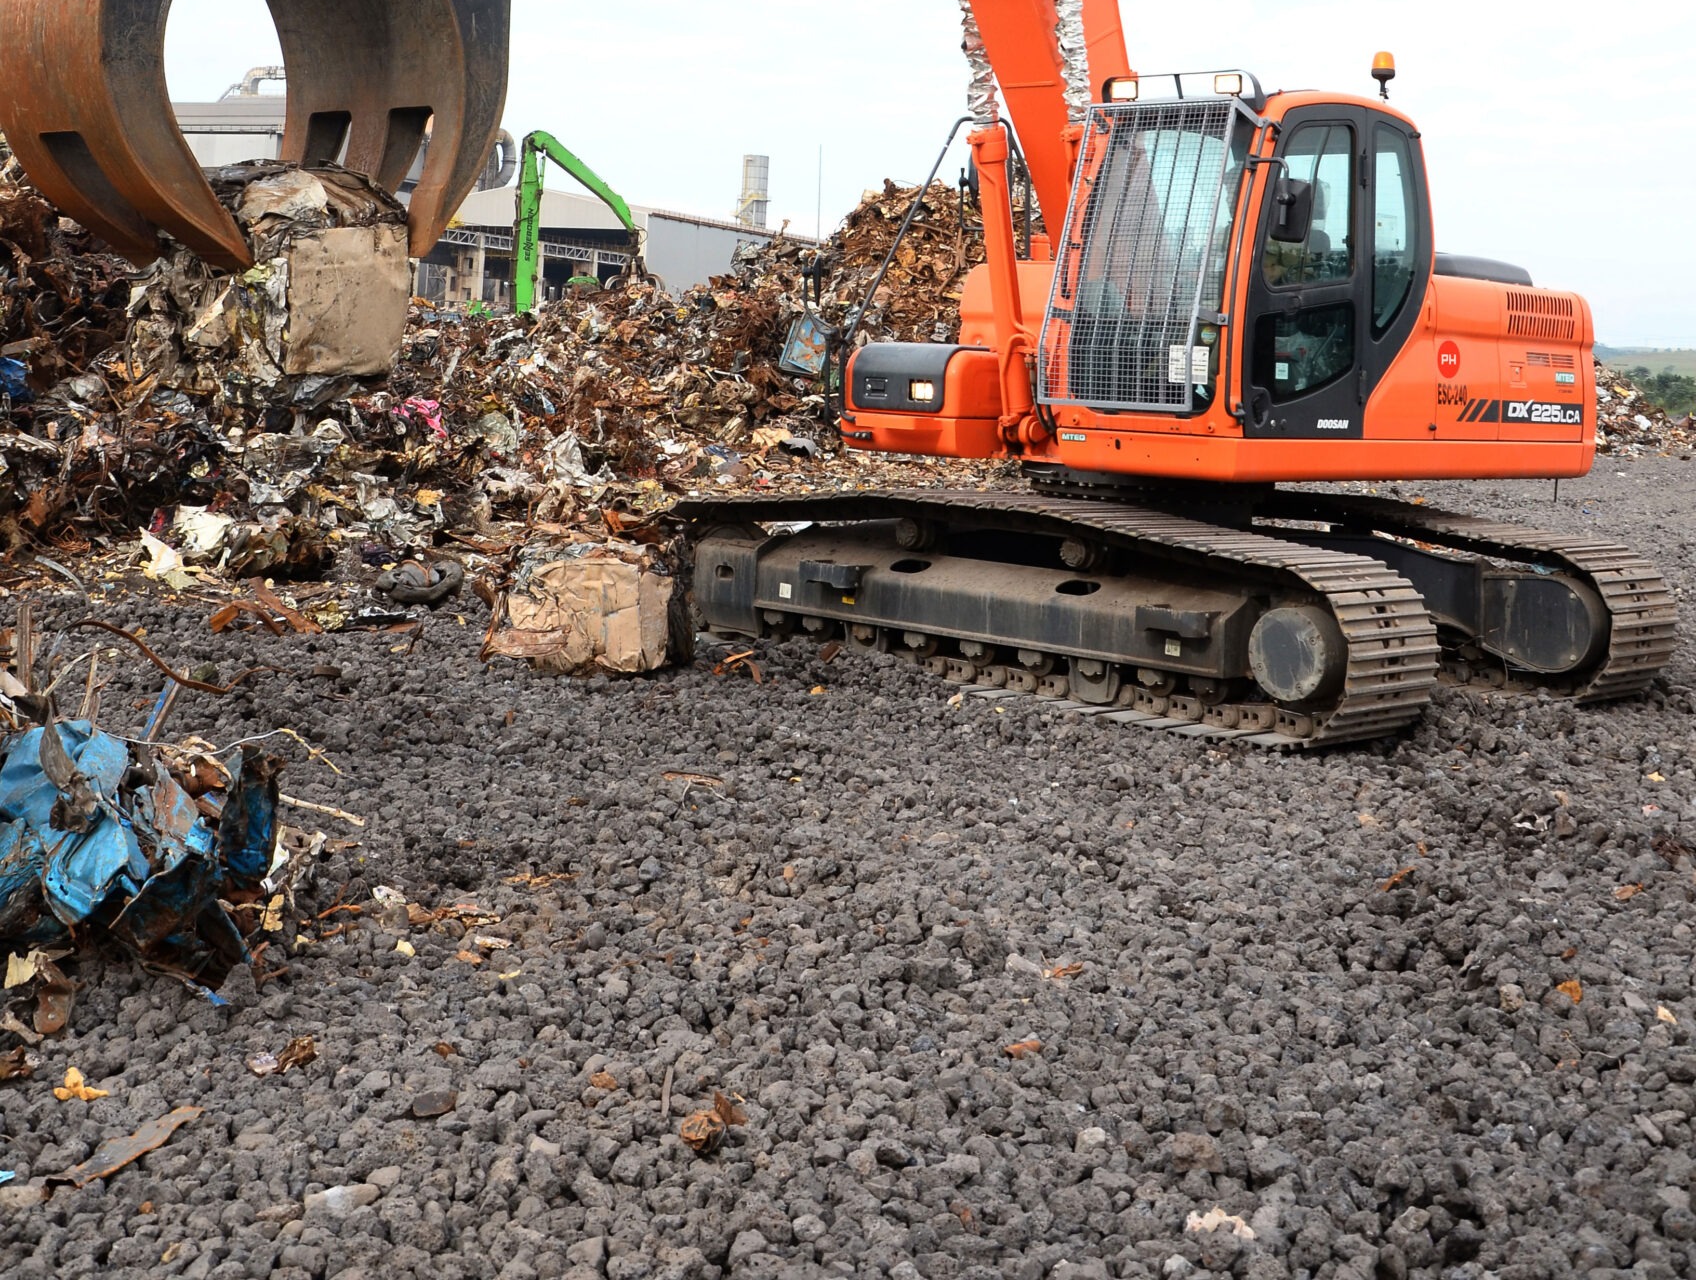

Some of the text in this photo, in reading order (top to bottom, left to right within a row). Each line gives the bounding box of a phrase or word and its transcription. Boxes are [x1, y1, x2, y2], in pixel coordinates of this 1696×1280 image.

[1441, 354, 1457, 365] PH
[1438, 383, 1467, 406] ESC-240
[1317, 419, 1349, 429] DOOSAN
